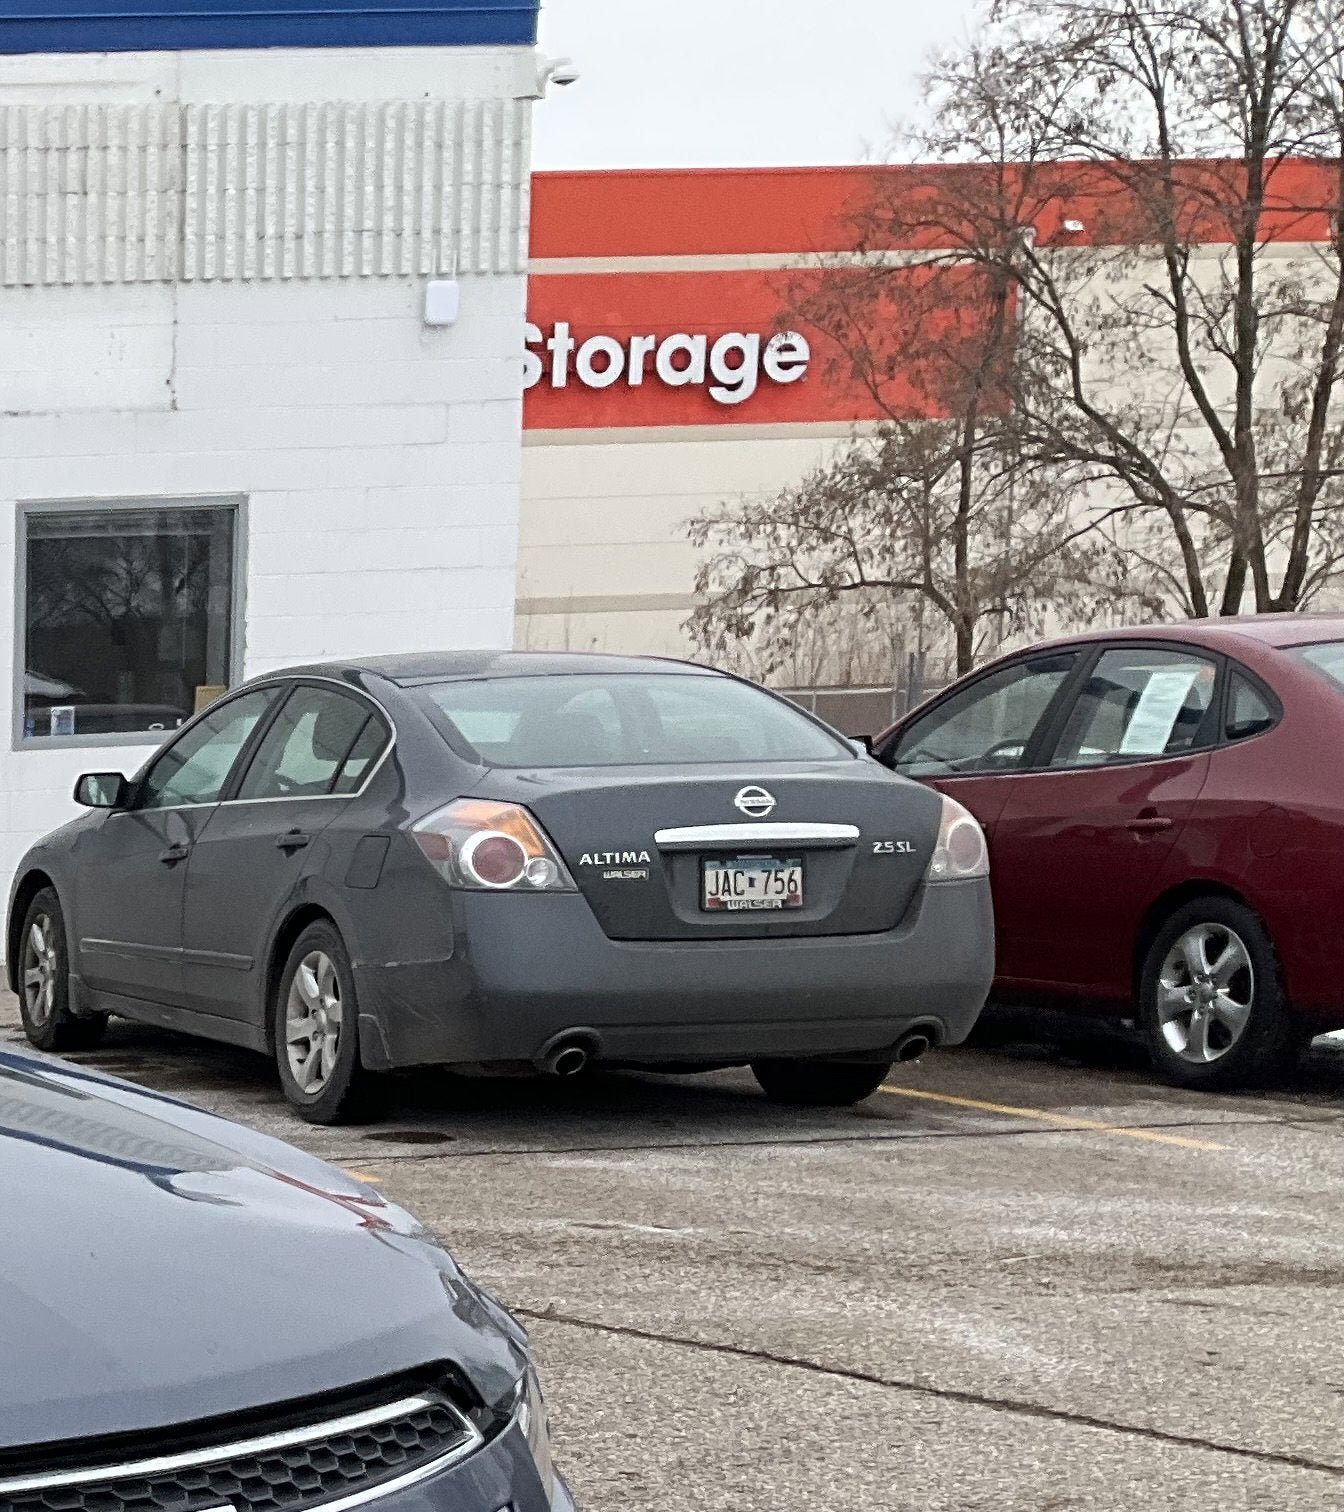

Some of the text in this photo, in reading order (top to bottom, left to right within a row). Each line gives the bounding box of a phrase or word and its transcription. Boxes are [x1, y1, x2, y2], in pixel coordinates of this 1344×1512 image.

[579, 851, 651, 865] ALTIMA
[708, 868, 798, 896] JAC 756
[727, 898, 783, 911] WALSER
